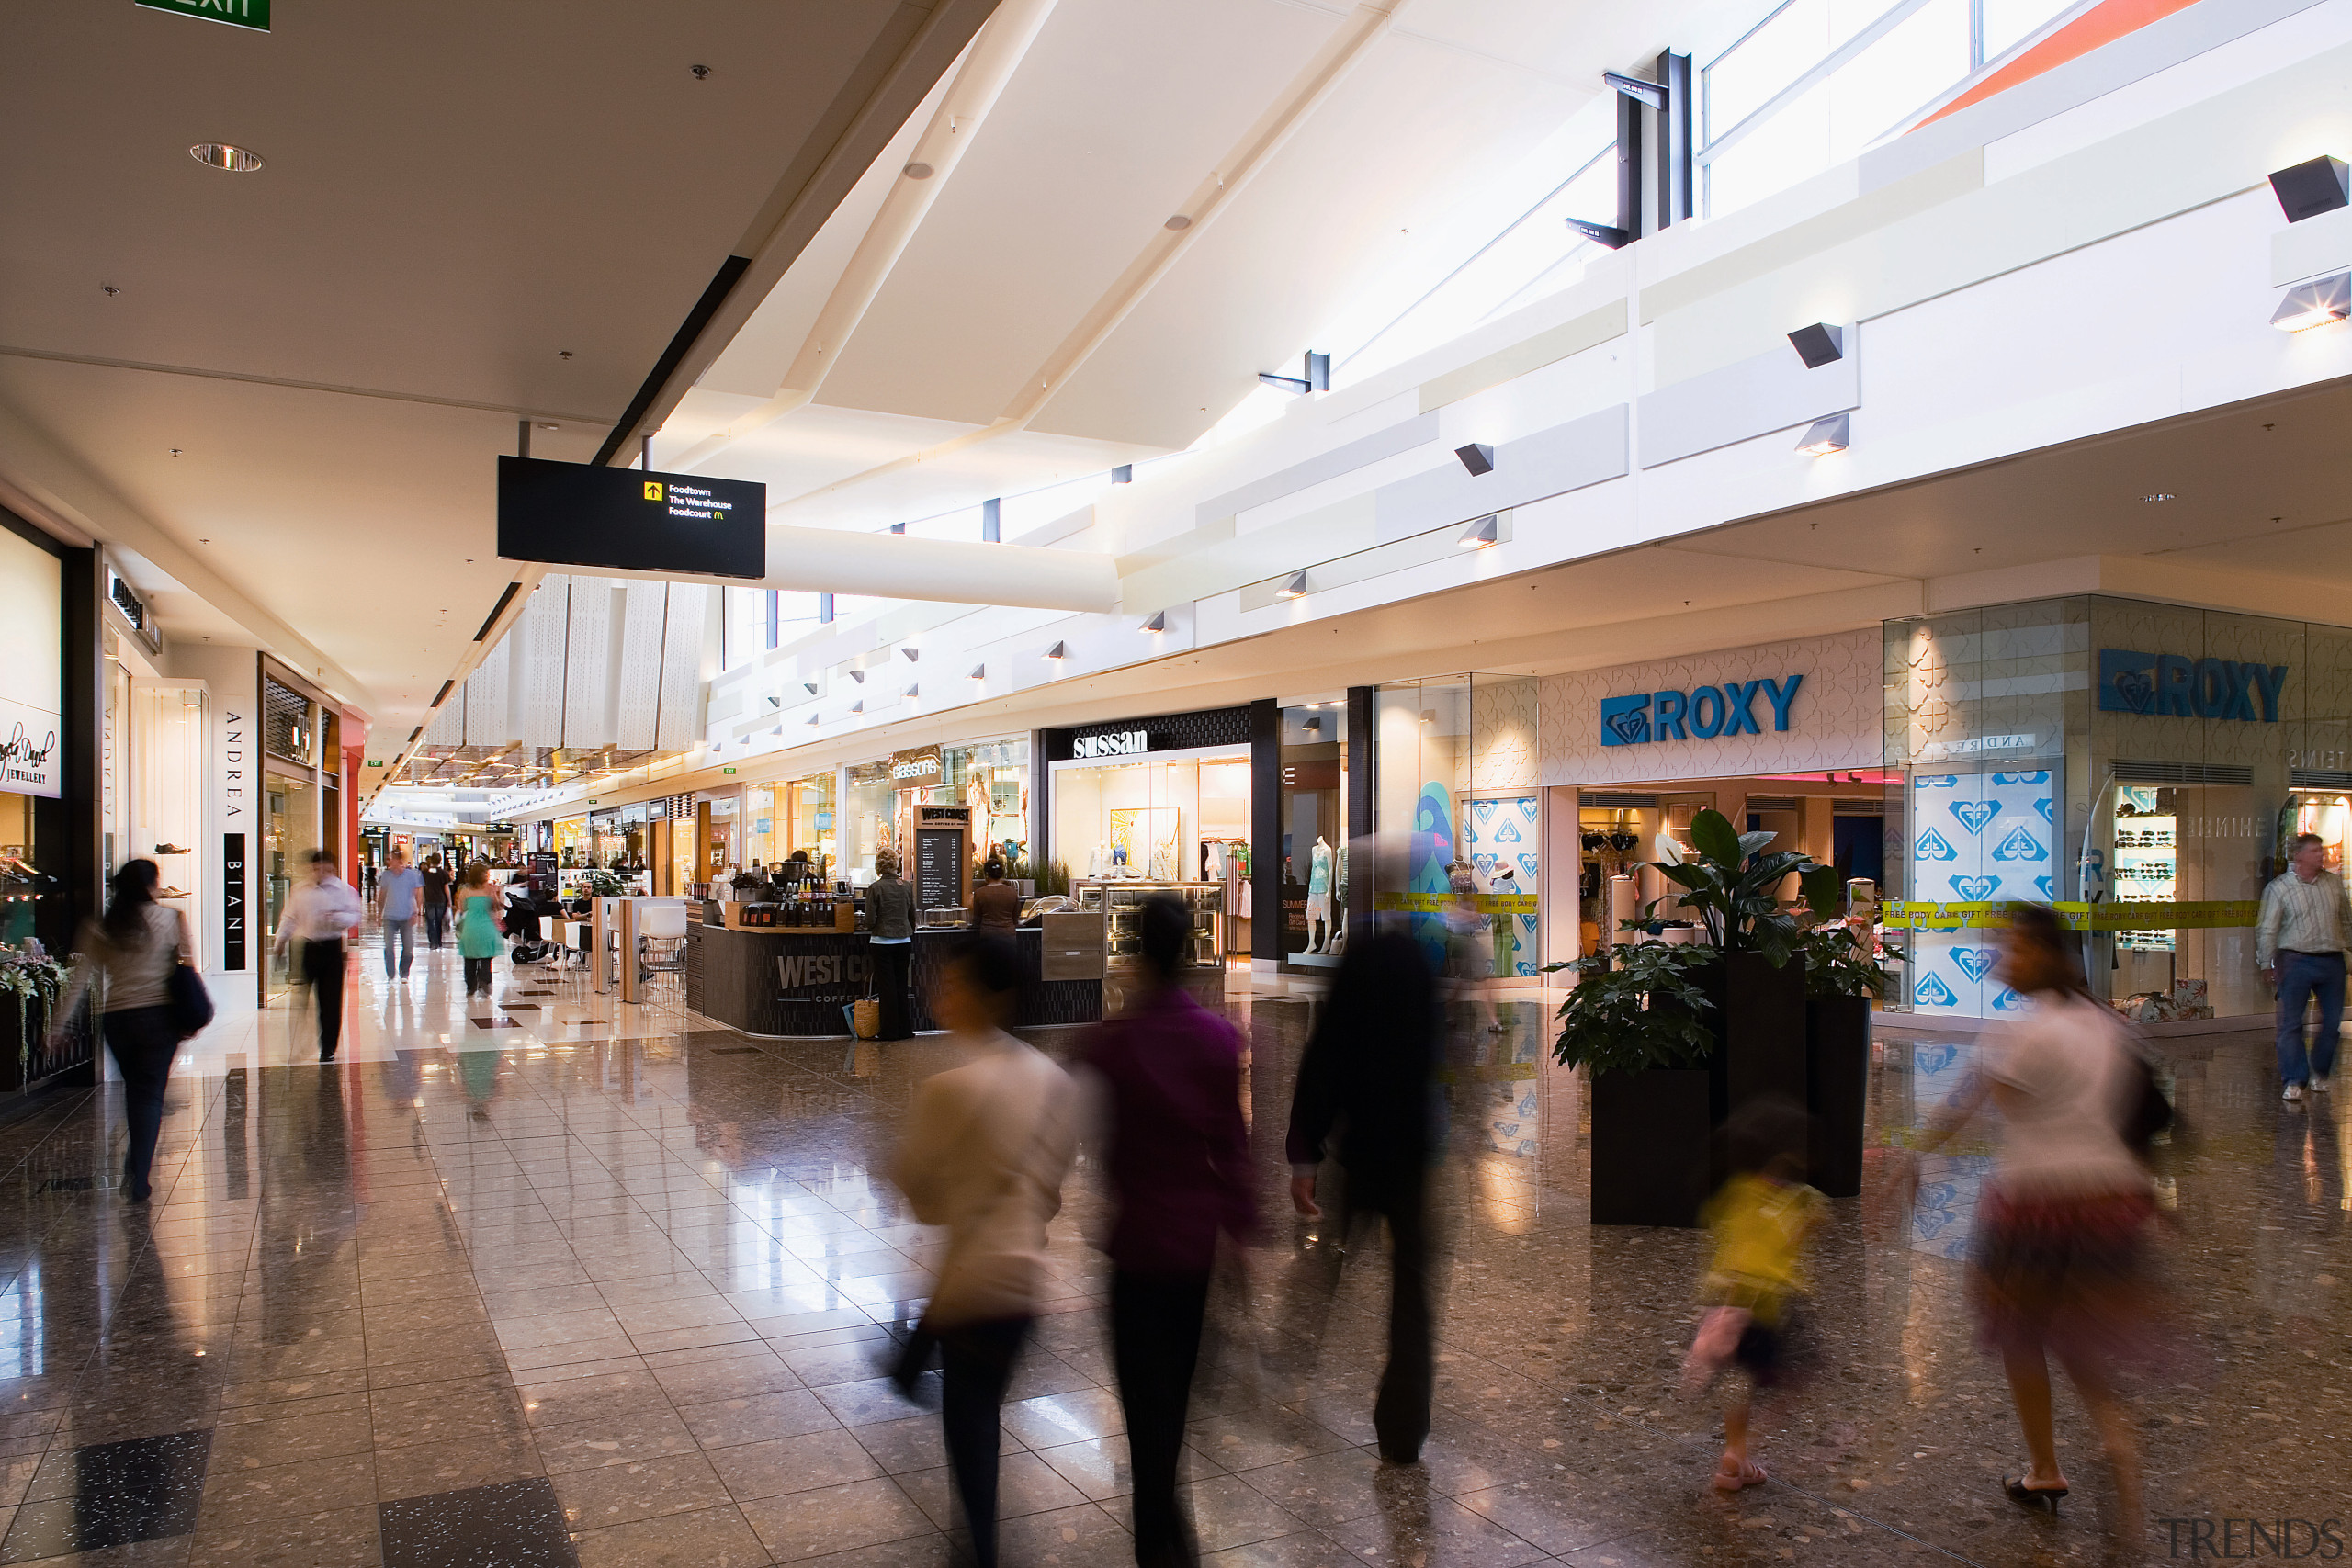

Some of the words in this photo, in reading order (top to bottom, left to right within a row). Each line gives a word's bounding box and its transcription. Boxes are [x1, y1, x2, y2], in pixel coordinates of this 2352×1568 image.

[669, 484, 711, 497] Foodtown
[669, 495, 685, 505] The
[685, 497, 732, 510] Warehouse
[669, 506, 712, 519] Foodcourt
[2156, 654, 2289, 723] ROXY
[1653, 674, 1804, 741] ROXY
[1073, 730, 1149, 759] sussan
[227, 711, 242, 817] ANDREA
[6, 768, 47, 784] JEWELLERY
[922, 808, 944, 821] WEST
[228, 861, 242, 944] BIANI
[1884, 910, 1905, 919] FREE
[1984, 910, 2007, 919] FREE
[2069, 911, 2090, 919] GIFT
[777, 955, 843, 990] WEST
